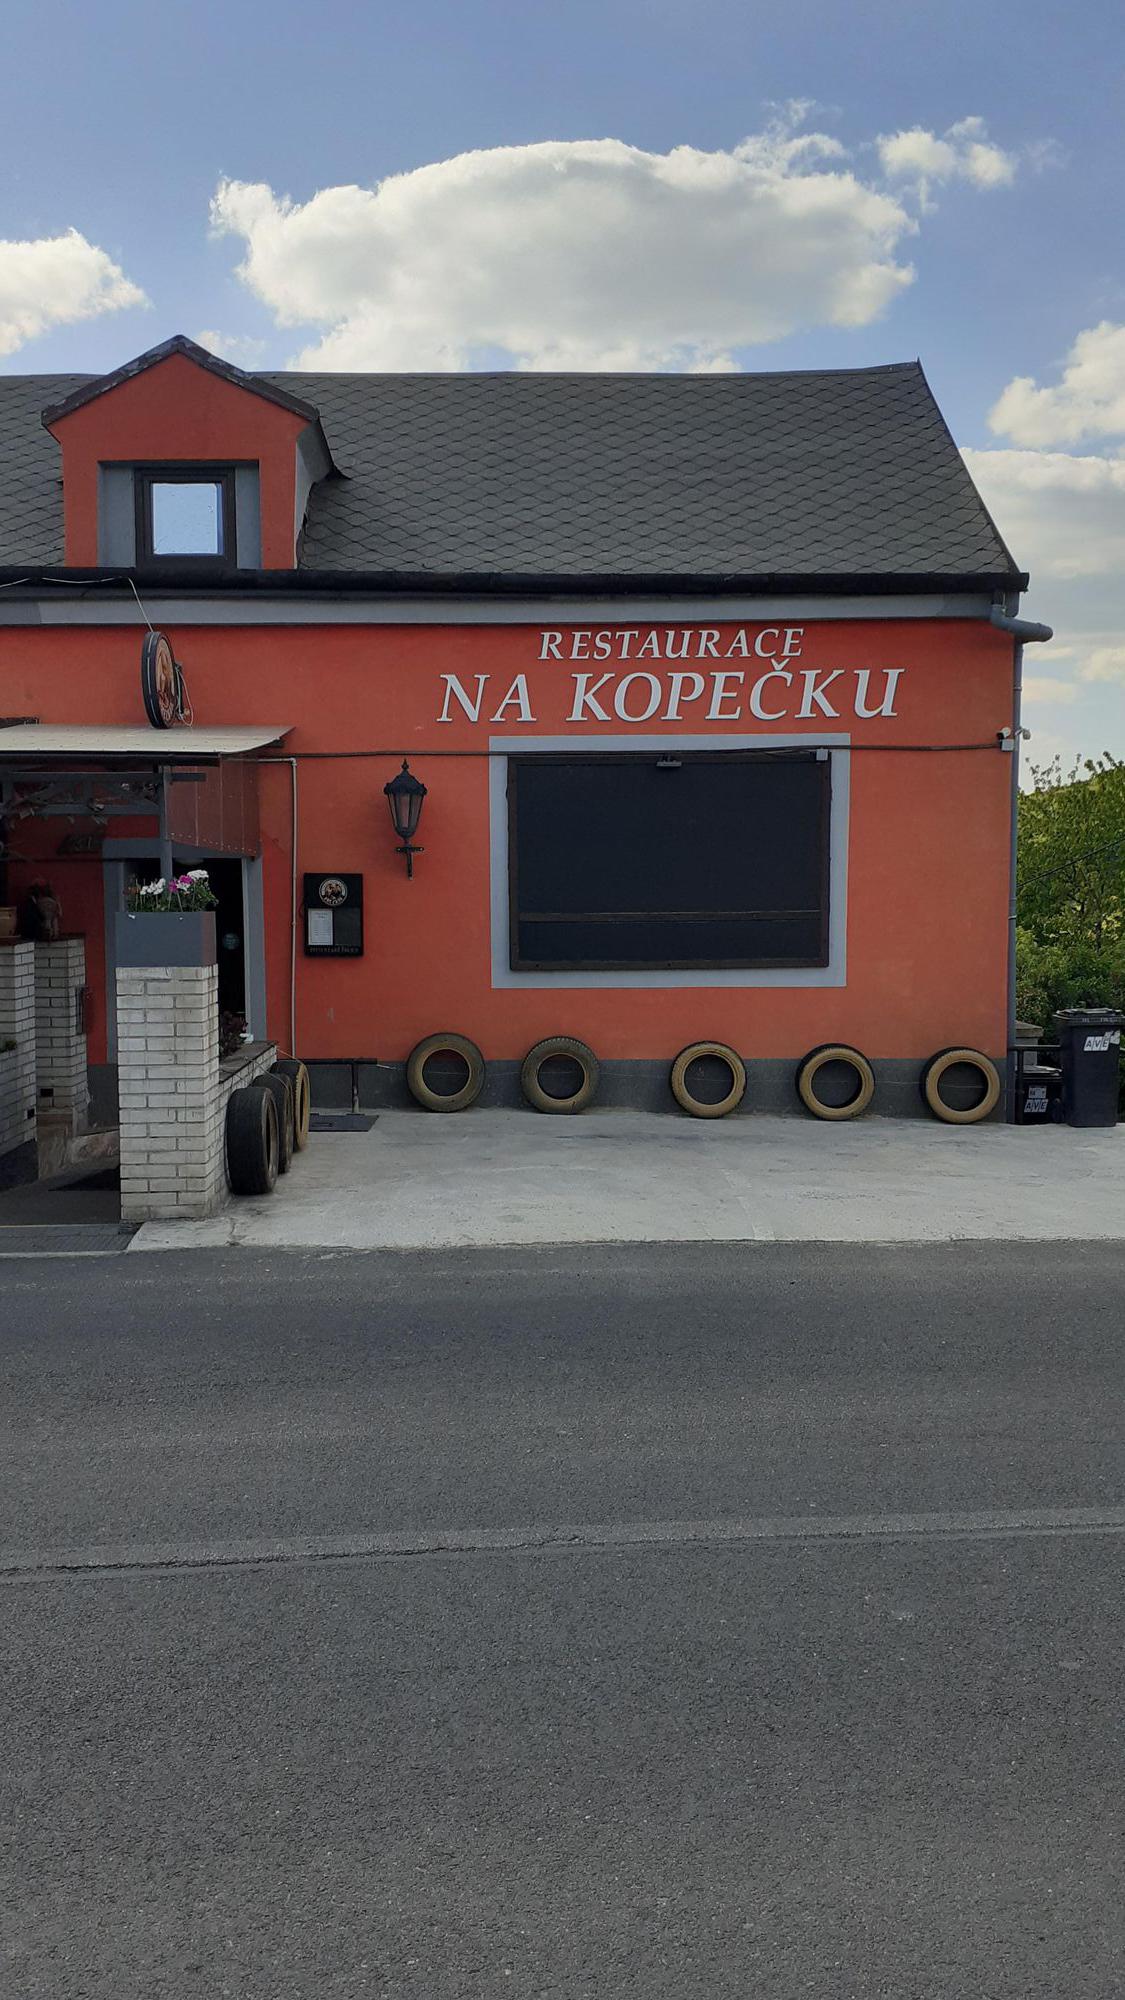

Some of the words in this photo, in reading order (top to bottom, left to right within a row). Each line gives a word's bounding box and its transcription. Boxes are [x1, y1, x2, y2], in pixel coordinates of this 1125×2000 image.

[537, 627, 804, 660] RESTAURACE
[436, 673, 537, 722] NA
[566, 658, 905, 722] KOPEČKU
[1085, 1038, 1109, 1050] AVE
